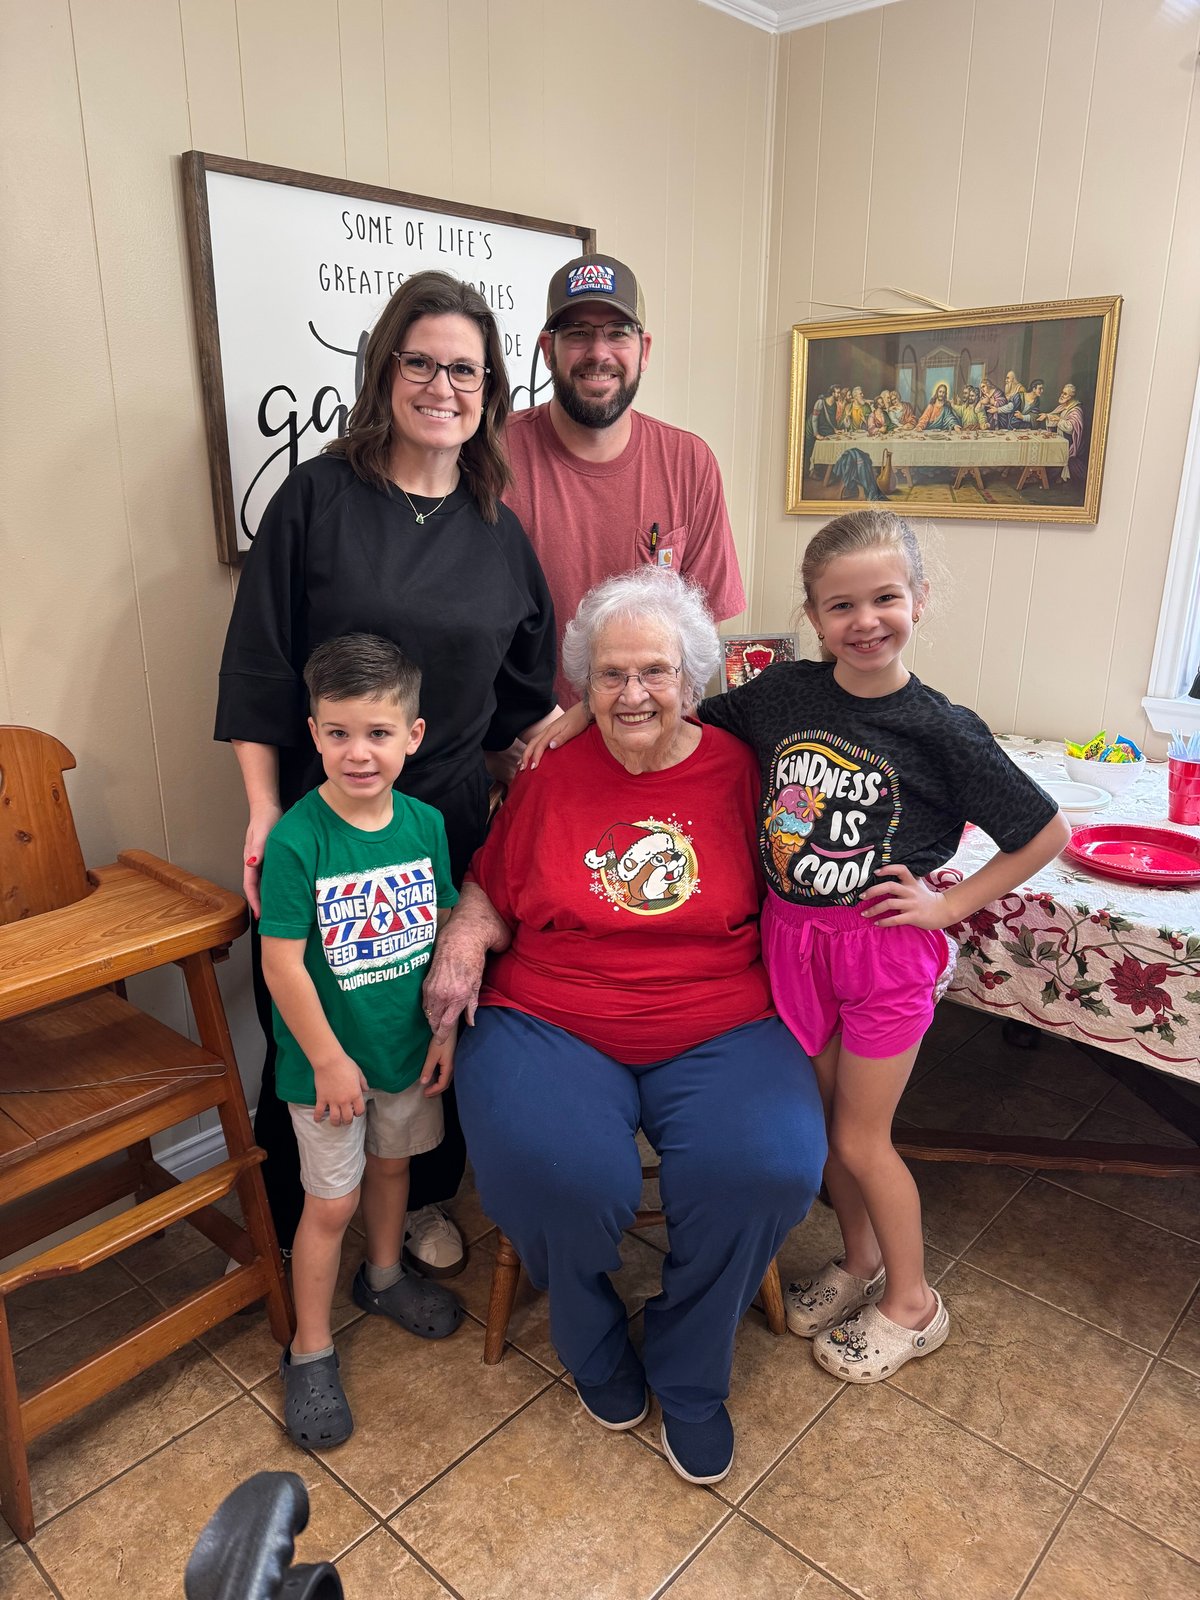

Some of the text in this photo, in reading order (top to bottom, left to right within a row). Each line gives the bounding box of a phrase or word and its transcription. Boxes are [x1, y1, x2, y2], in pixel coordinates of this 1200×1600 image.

[342, 211, 492, 260] SOME OF LIFE'S
[319, 263, 414, 297] GREATES
[830, 810, 866, 847] IS
[320, 883, 433, 924] LONE STAR
[327, 943, 358, 966] FEED
[410, 952, 430, 970] FEED
